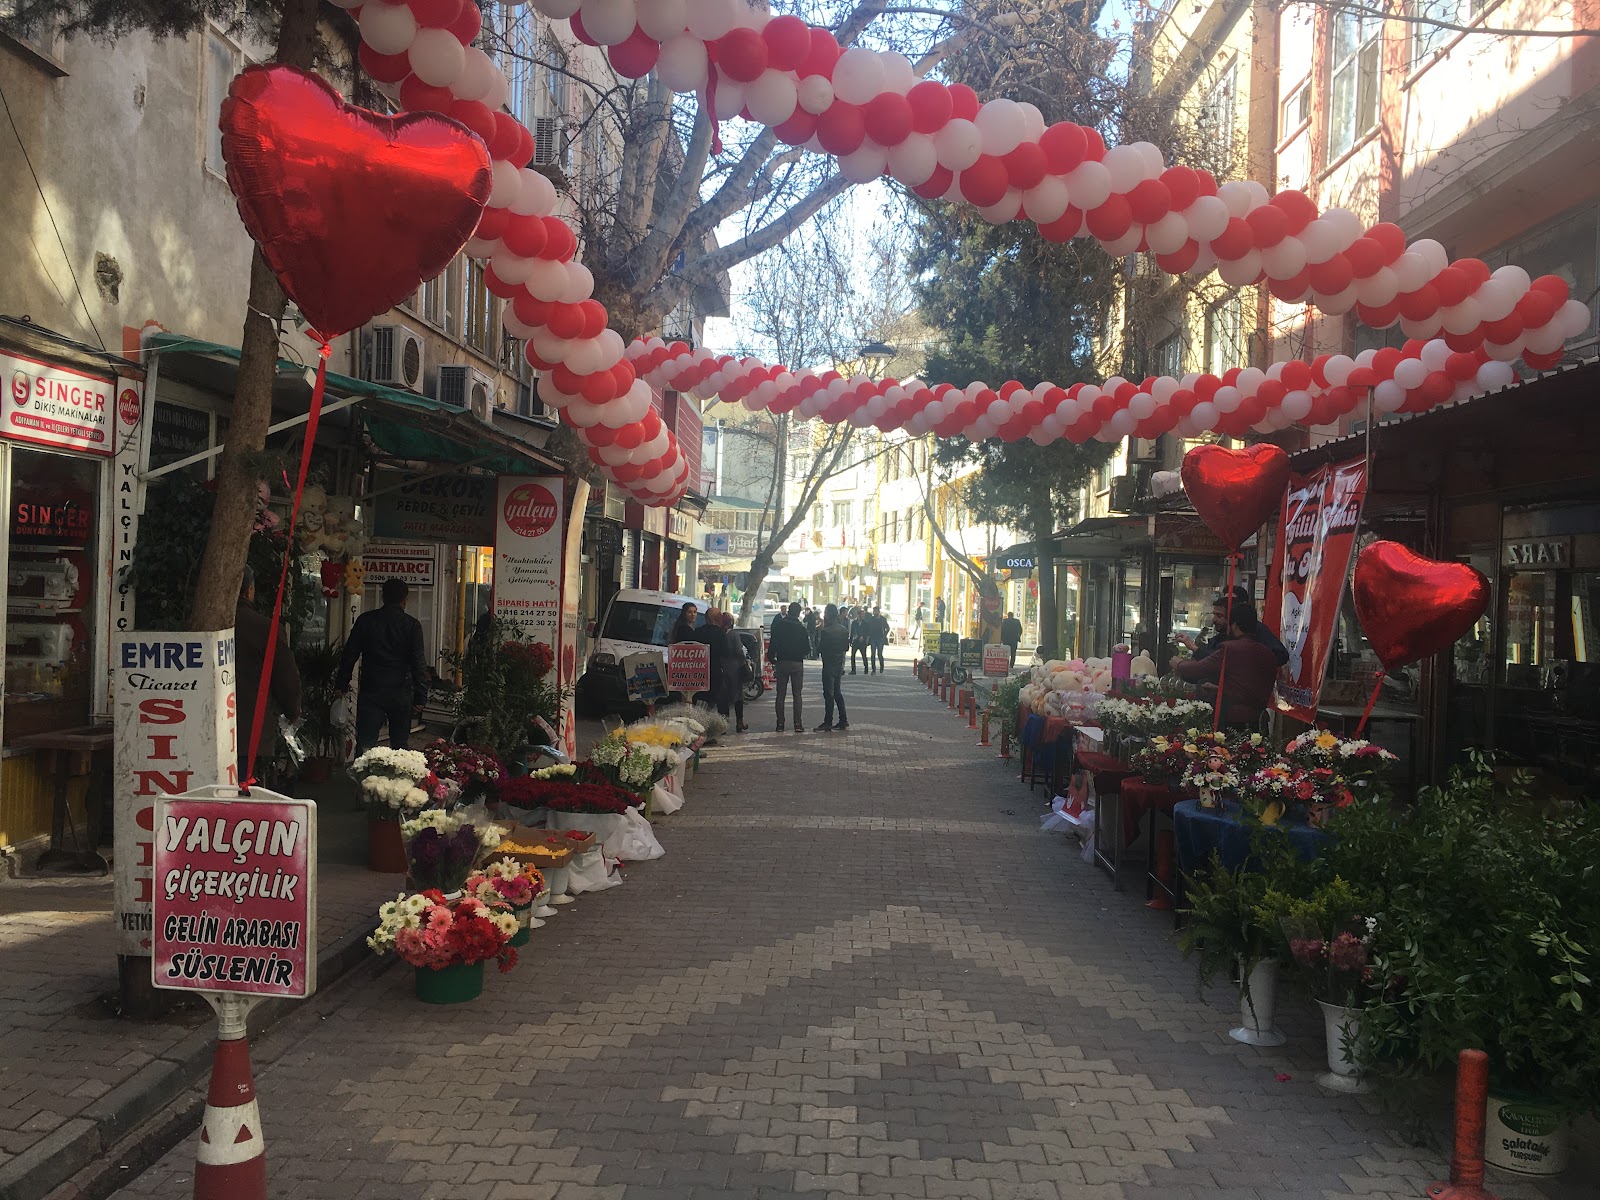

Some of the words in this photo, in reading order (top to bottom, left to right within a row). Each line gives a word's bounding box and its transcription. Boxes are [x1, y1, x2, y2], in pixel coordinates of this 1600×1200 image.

[35, 376, 105, 412] SINGER
[15, 416, 39, 427] ADIYAMAN
[34, 400, 56, 416] DİKİŞ
[58, 405, 105, 425] MAKİNALARI
[18, 503, 89, 528] SINGER
[120, 464, 133, 560] YALÇIN
[396, 500, 437, 513] PERDE
[439, 503, 448, 515] &
[506, 498, 555, 523] yalçın
[527, 529, 536, 537] 27
[497, 598, 531, 608] SİPARİŞ
[532, 599, 558, 608] HATTI
[121, 642, 203, 671] EMRE
[670, 661, 706, 670] ÇİÇEKÇİLİK
[671, 649, 706, 660] YALÇIN
[128, 673, 197, 691] Ticaret
[166, 815, 299, 864] YALÇIN
[165, 864, 298, 904] ÇİÇEKÇİLİK
[164, 910, 219, 943] GELİN
[222, 917, 299, 949] ARABASI
[168, 947, 293, 987] SÜSLENİR
